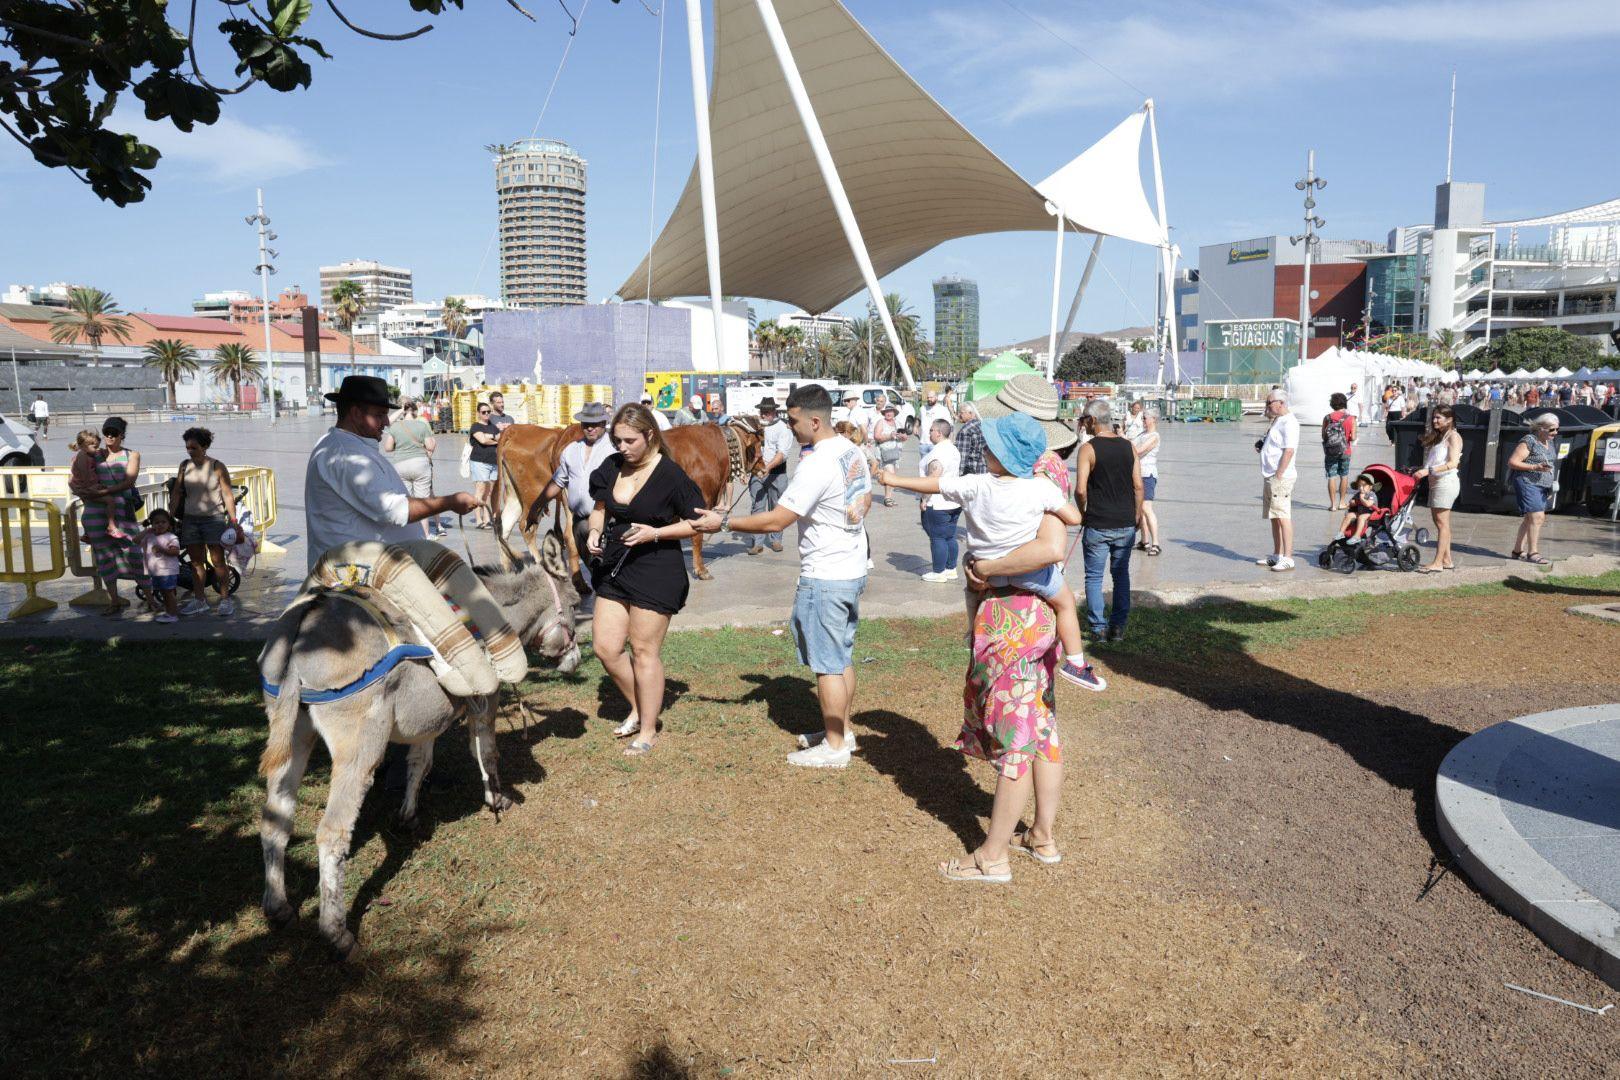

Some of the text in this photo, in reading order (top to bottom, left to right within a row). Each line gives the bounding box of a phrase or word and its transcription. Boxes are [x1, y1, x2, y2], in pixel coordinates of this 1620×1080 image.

[1233, 322, 1285, 331] ESTACIÓN DE
[1233, 331, 1283, 346] GUAGUAS
